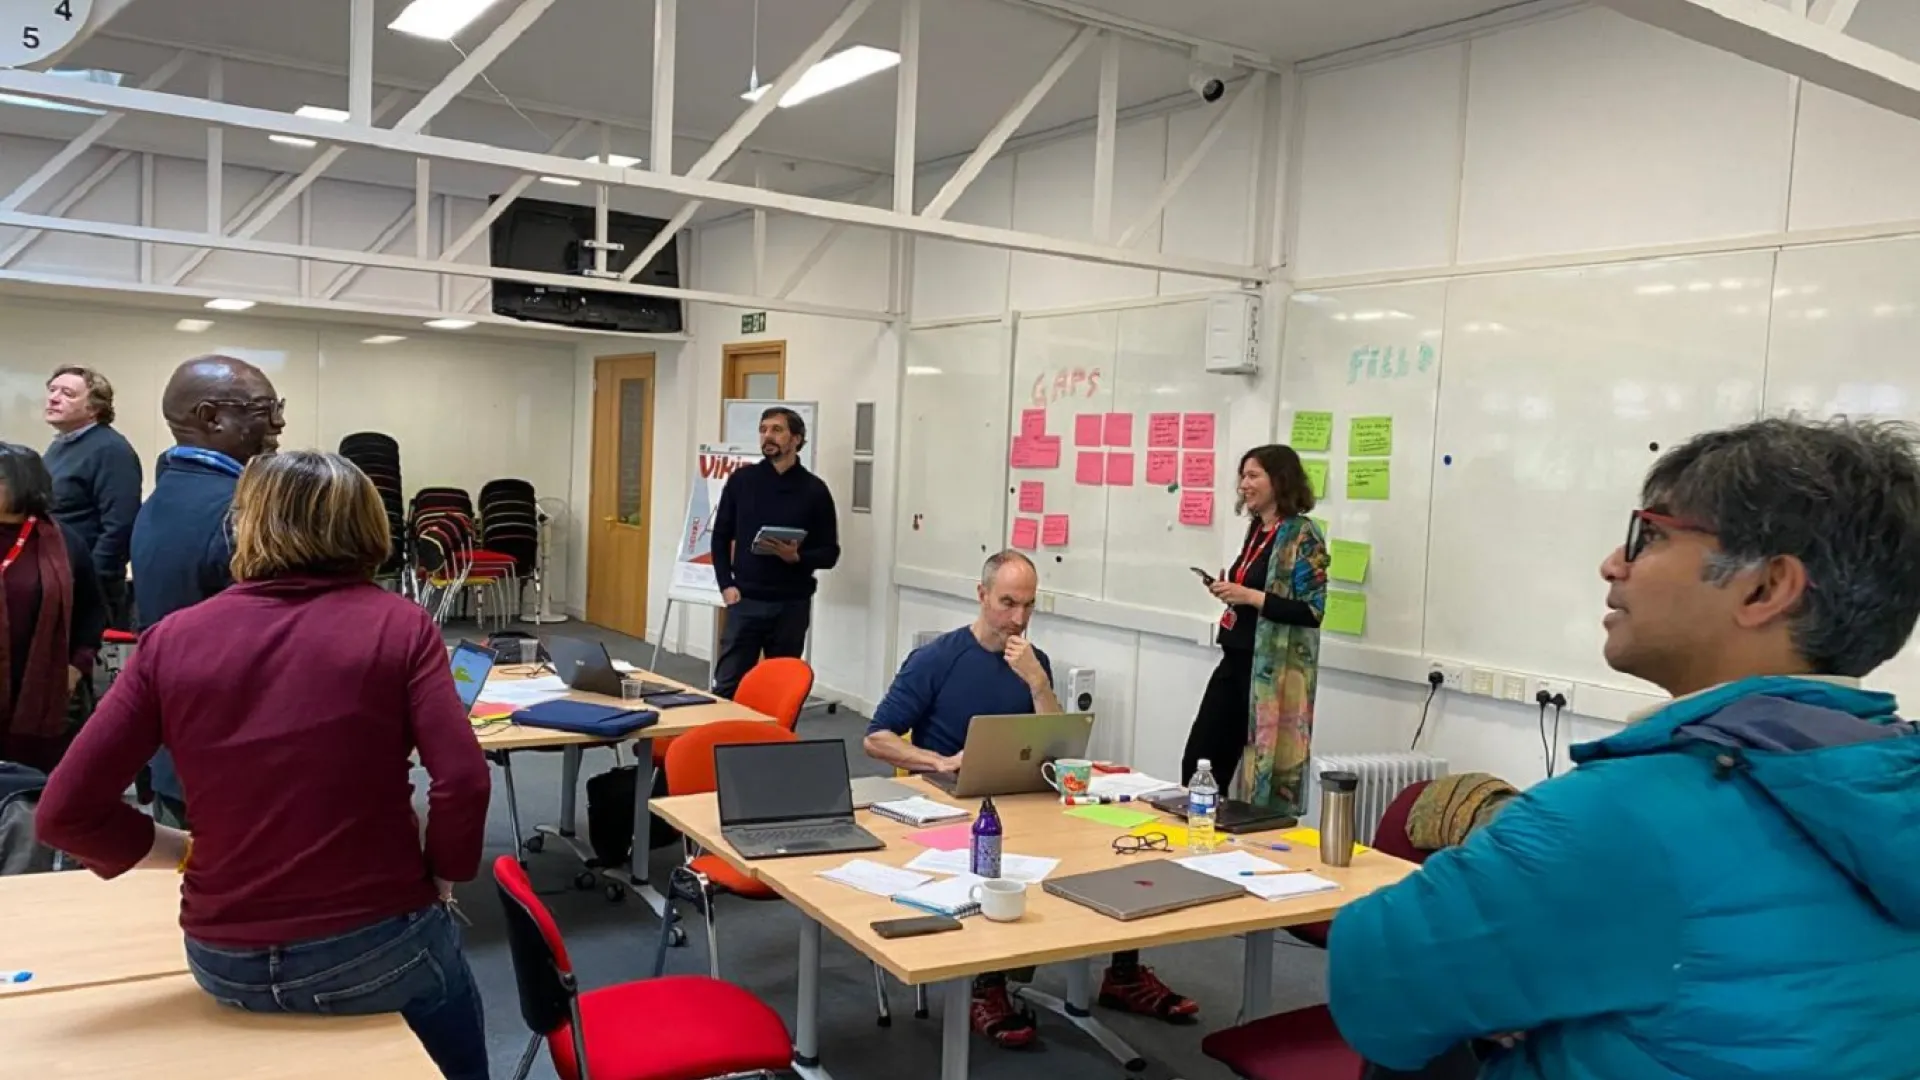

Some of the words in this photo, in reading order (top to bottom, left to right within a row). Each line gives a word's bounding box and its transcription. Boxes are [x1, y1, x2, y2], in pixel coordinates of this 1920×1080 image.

[54, 0, 73, 21] 4
[23, 26, 40, 49] 5
[699, 454, 753, 480] Viki
